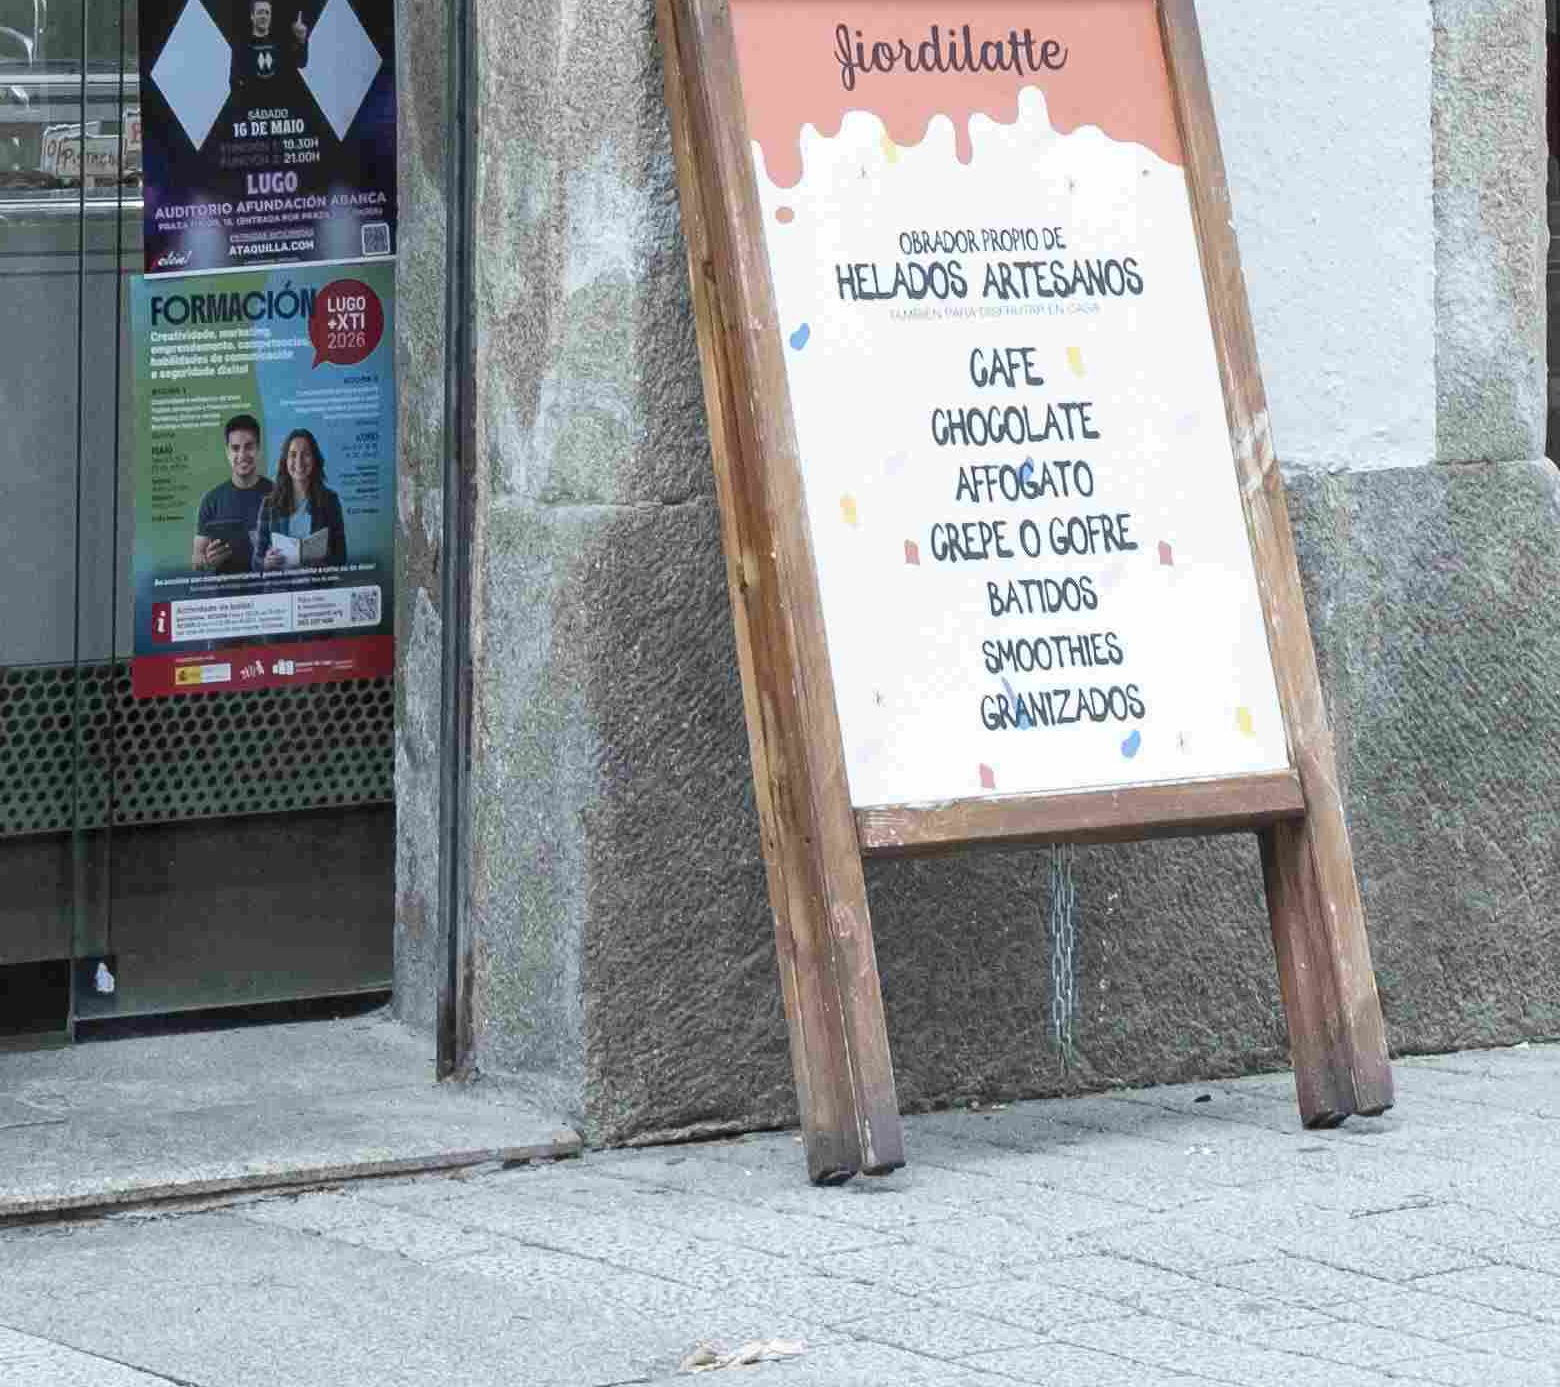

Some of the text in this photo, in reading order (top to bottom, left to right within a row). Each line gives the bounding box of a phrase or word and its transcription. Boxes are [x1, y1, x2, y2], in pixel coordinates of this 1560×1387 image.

[834, 23, 1068, 92] fiordilatte
[234, 118, 305, 137] 16 DE MAIO
[248, 108, 288, 120] SÁBADO
[247, 170, 298, 195] LUGO
[155, 191, 387, 220] AUDITORIO AFUNDACIÓN ABANCA
[229, 240, 315, 256] ATAQUILLA.COM
[899, 226, 1067, 255] OBRADOR PROPIO DE
[835, 257, 1144, 301] HELADOS ARTESANOS
[328, 296, 366, 312] LUGO
[328, 315, 365, 330] +XTI
[328, 331, 366, 349] 2026
[970, 346, 1044, 388] CAFE
[931, 401, 1101, 447] CHOCOLATE
[955, 460, 1094, 503] AFFOGATO
[931, 514, 1138, 563] CREPE O GOFRE
[986, 575, 1098, 617] BATIDOS
[982, 631, 1124, 675] SMOOTHIES
[980, 683, 1145, 731] GRANIZADOS
